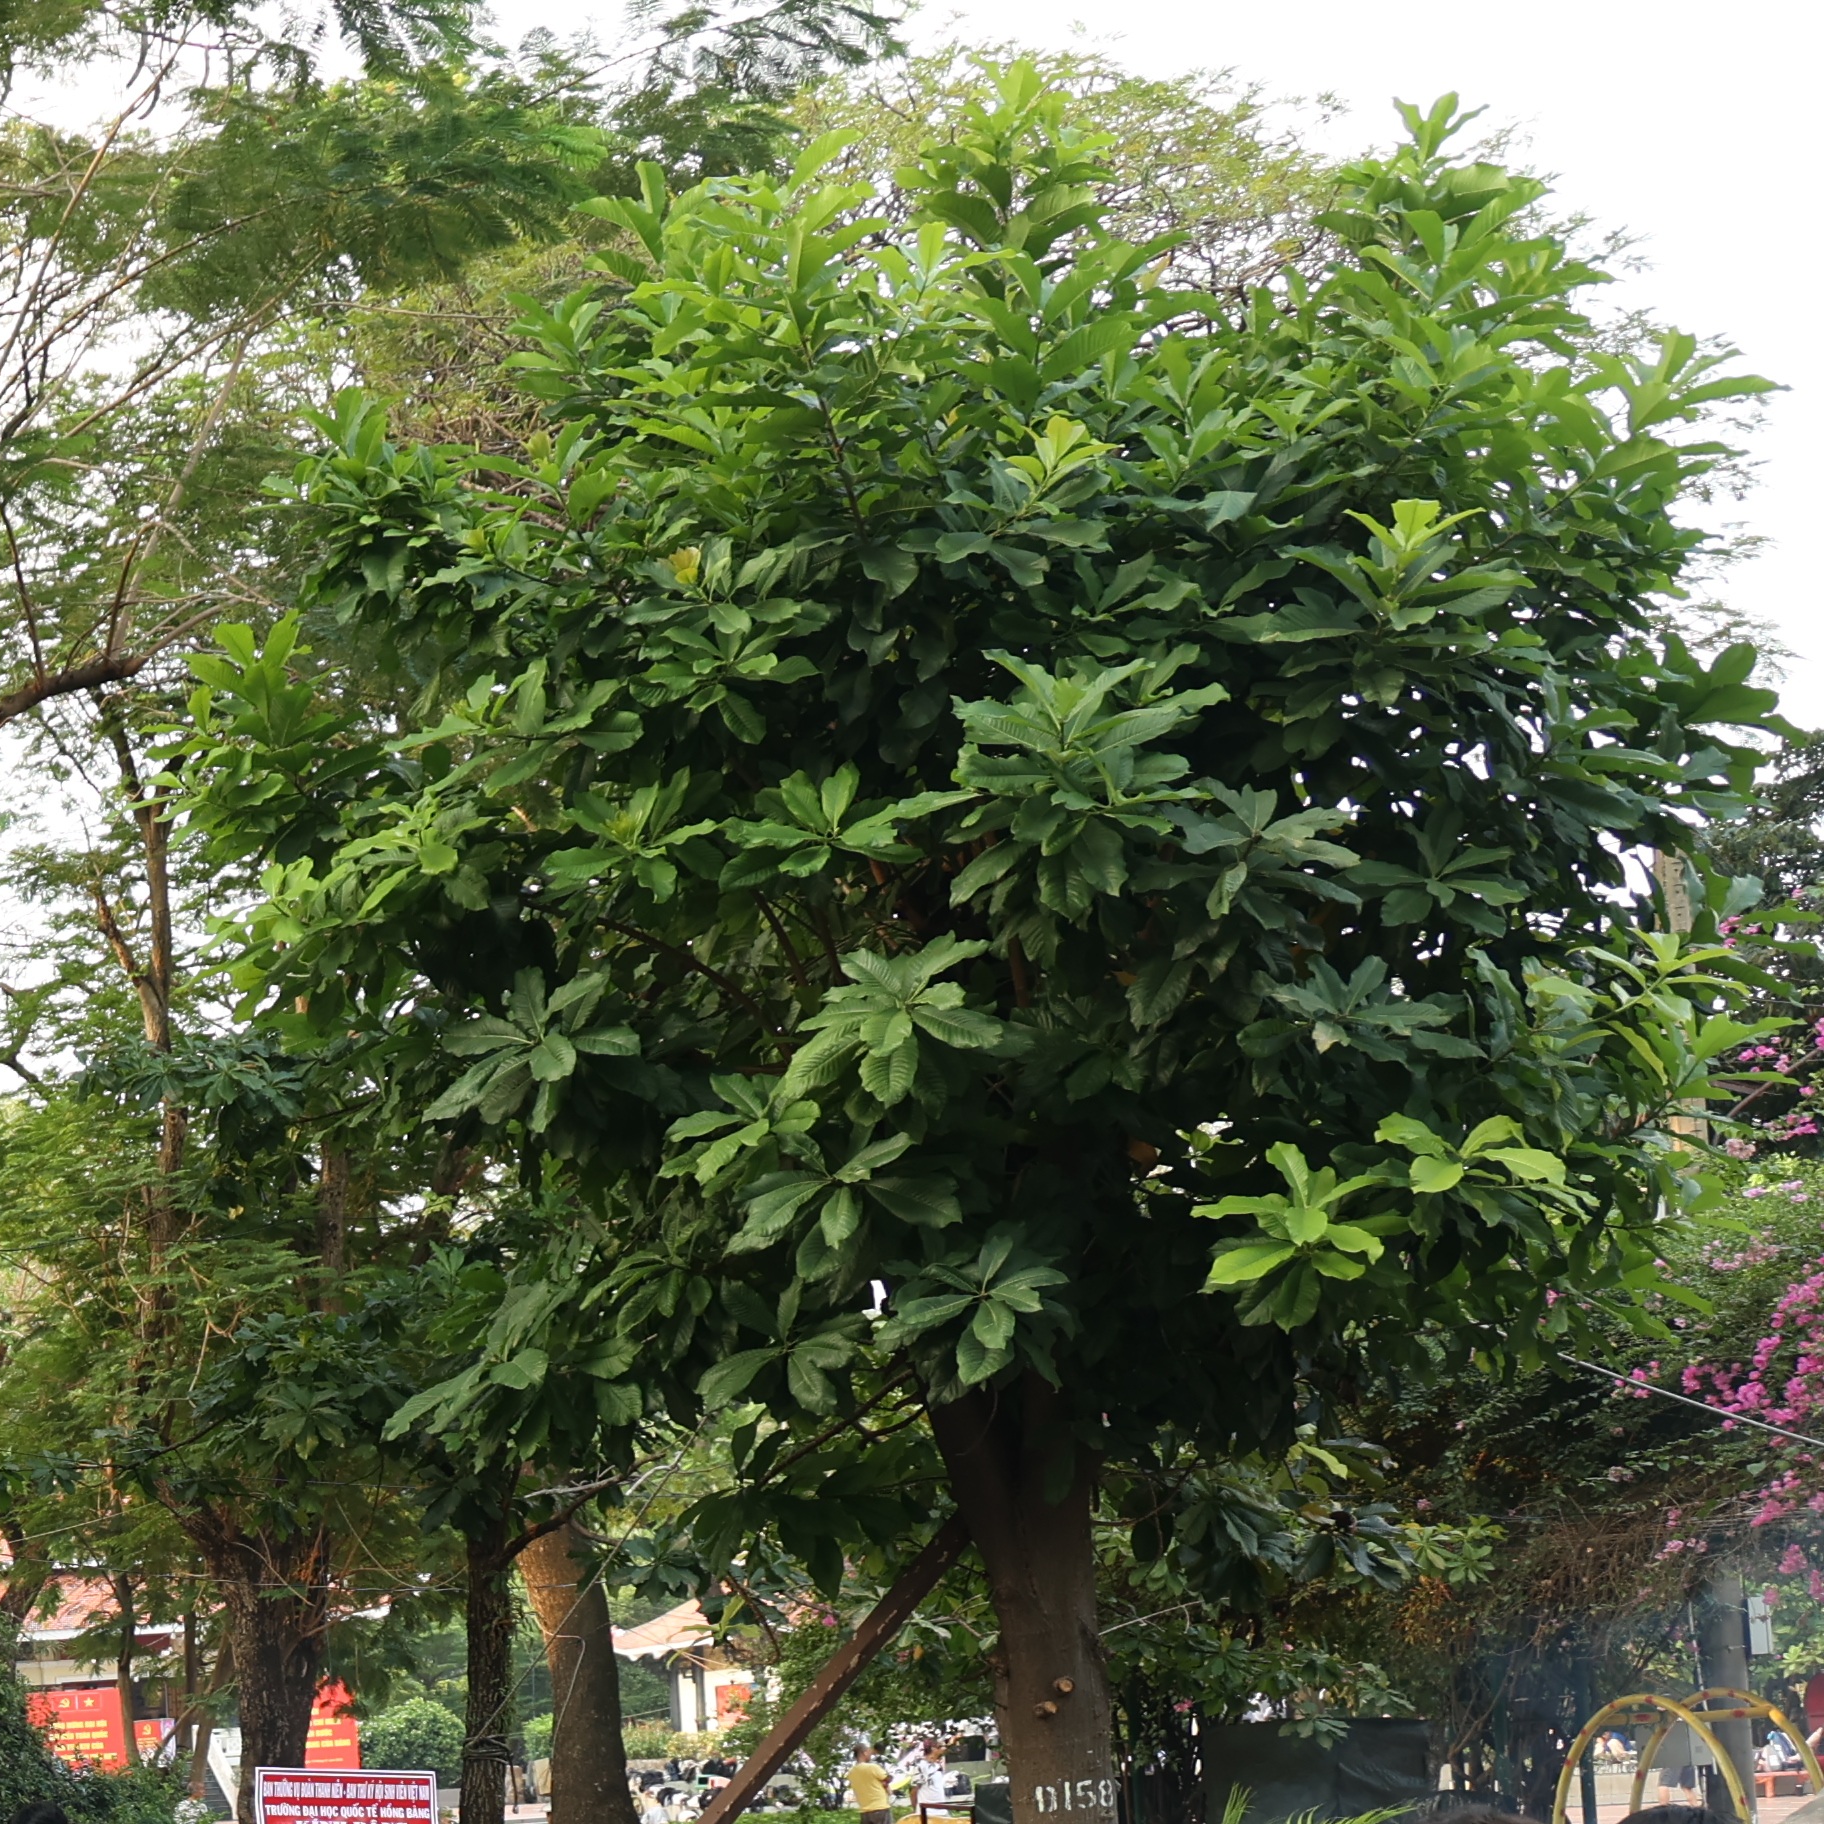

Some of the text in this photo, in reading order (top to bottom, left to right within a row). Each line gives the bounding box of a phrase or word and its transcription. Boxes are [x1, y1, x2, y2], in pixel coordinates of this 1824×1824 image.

[265, 1802, 301, 1817] TRƯỜNG
[302, 1805, 318, 1819] ĐẠI
[320, 1806, 339, 1819] HỌC
[340, 1802, 365, 1818] QUỐC
